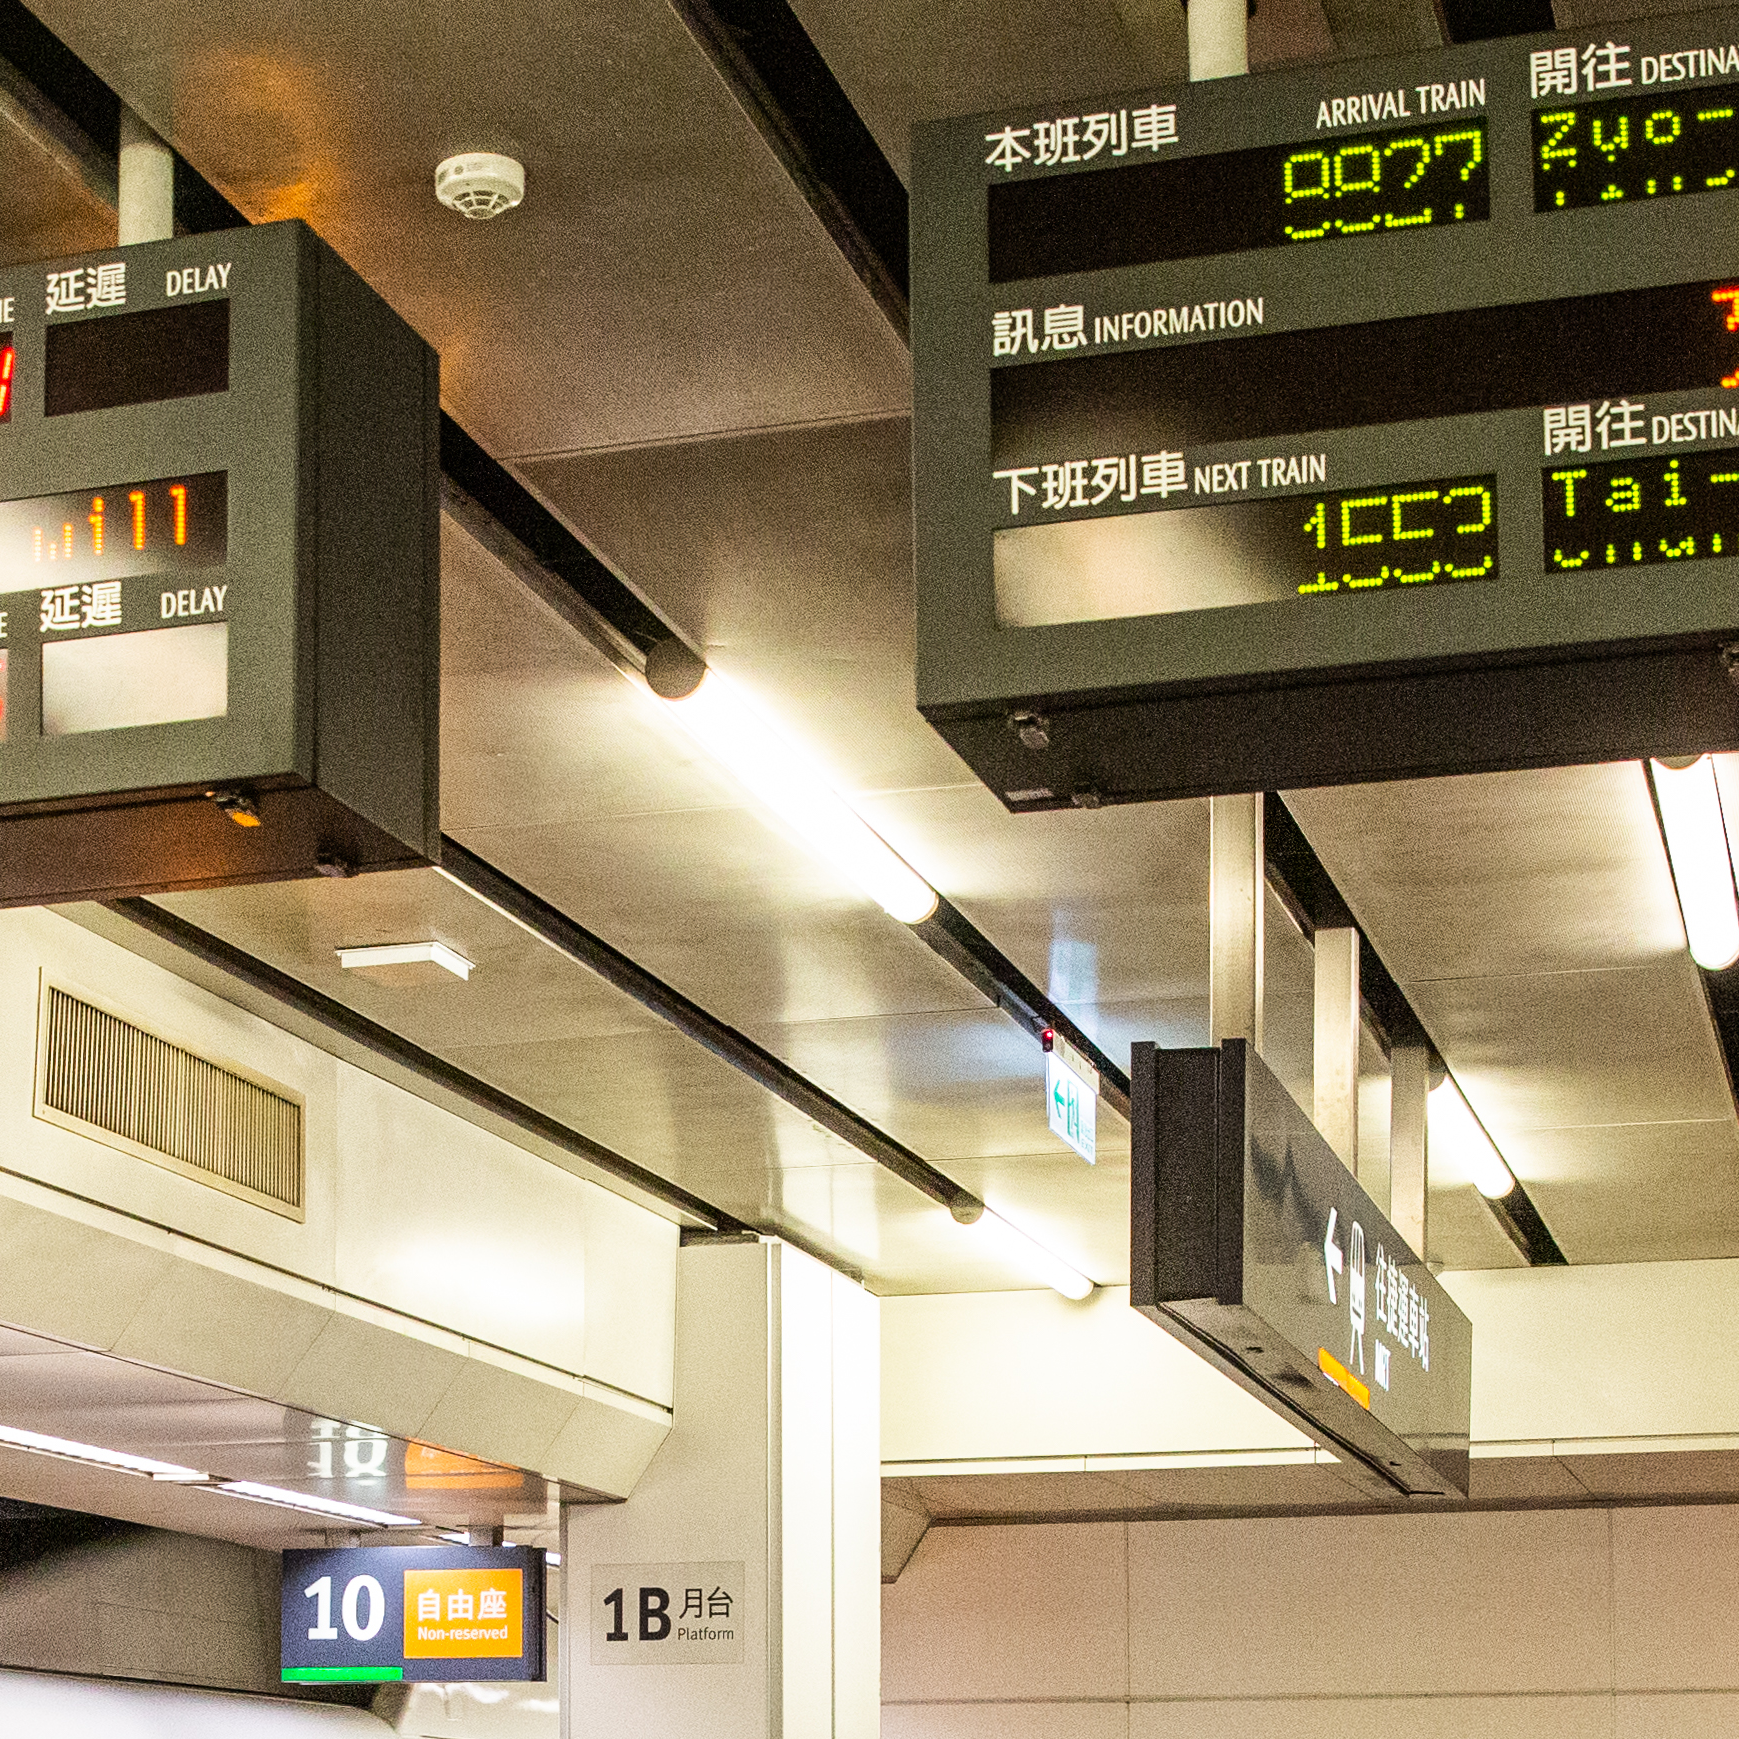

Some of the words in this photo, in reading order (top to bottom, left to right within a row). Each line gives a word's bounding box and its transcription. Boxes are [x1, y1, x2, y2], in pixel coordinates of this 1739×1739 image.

[1530, 42, 1634, 98] 開往
[1317, 89, 1410, 128] ARRIVAL
[1418, 79, 1486, 116] TRAIN
[985, 105, 1180, 172] 本班列車
[46, 263, 126, 315] 延遲
[166, 263, 231, 297] DELAY
[992, 304, 1088, 356] 訊息
[1095, 297, 1263, 343] INFORMATION
[1543, 401, 1647, 456] 開往
[993, 451, 1188, 515] 下班列車
[1195, 460, 1250, 494] NEXT
[1258, 454, 1327, 487] TRAIN
[40, 581, 122, 632] 延遲
[161, 587, 226, 618] DELAY
[1375, 1243, 1429, 1372] 往捷運車站
[304, 1574, 385, 1641] 10
[417, 1588, 508, 1621] 自由座
[417, 1625, 508, 1642] Non-reserved
[603, 1587, 672, 1642] 1B
[678, 1587, 733, 1619] 月台
[677, 1627, 734, 1643] Platform
